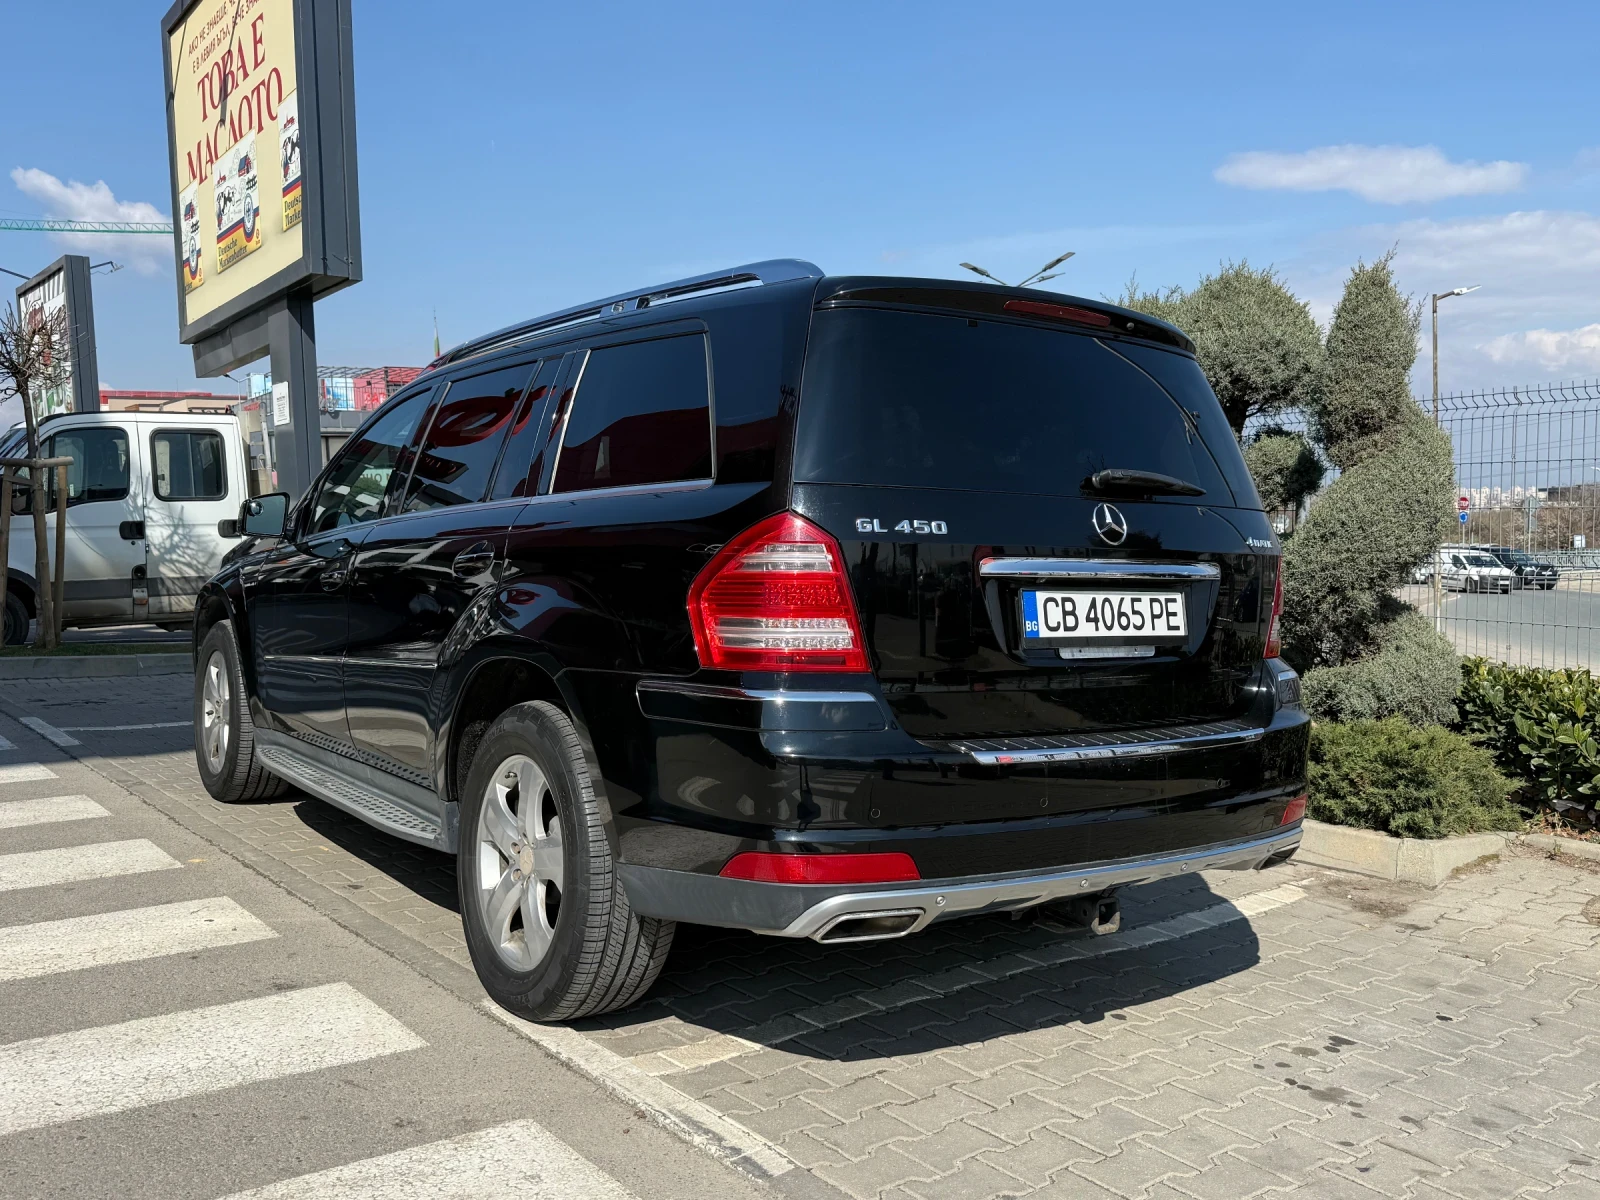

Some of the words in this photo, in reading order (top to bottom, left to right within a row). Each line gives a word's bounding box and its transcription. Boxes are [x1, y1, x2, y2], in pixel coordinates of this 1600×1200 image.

[188, 36, 199, 57] АКО
[199, 27, 206, 45] НЕ
[197, 36, 250, 123] ТОВА
[251, 12, 266, 72] Е
[187, 67, 283, 185] МАСЛОТО
[855, 518, 888, 533] GL
[894, 519, 948, 535] 450
[1025, 621, 1038, 632] BG
[1085, 597, 1146, 632] 4065
